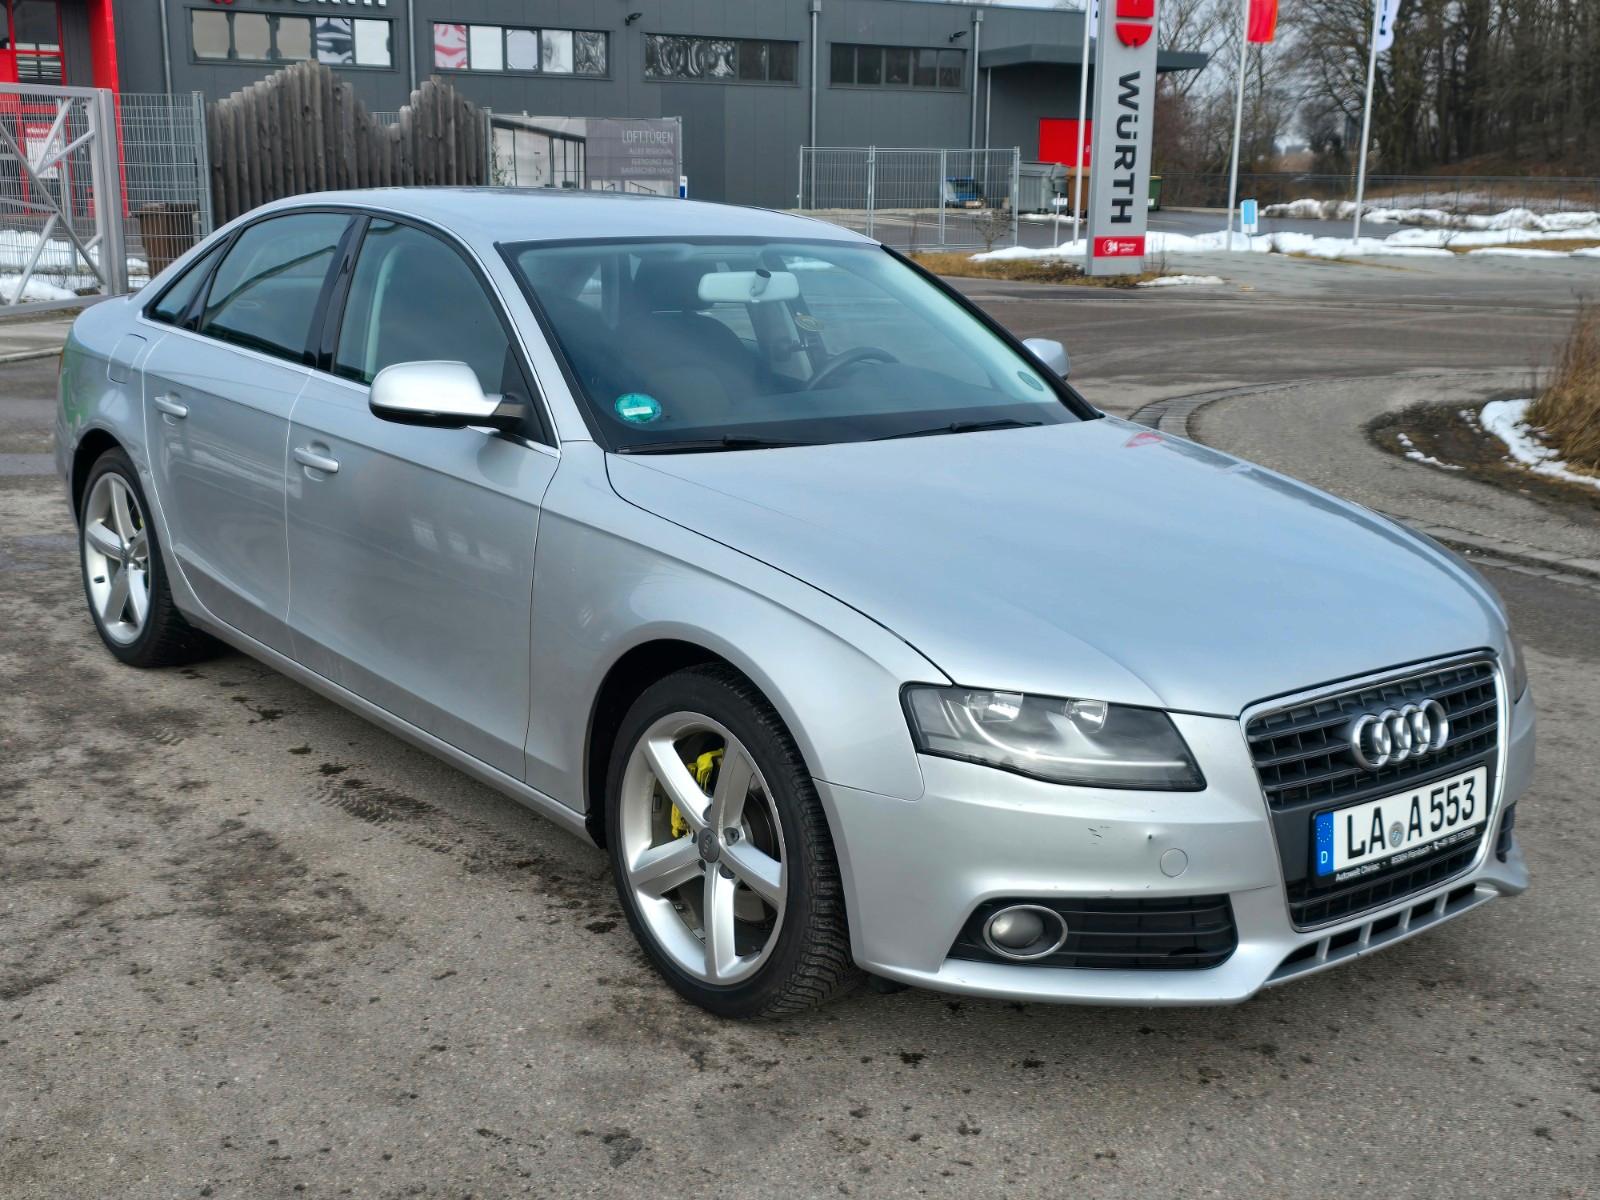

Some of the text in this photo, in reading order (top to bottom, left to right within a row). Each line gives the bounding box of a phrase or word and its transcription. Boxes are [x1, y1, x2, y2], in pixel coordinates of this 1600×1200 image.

[1111, 71, 1141, 224] WÜRTH
[1321, 850, 1328, 864] D
[1347, 806, 1386, 860] LA
[1407, 795, 1423, 842] A
[1430, 776, 1475, 832] 553
